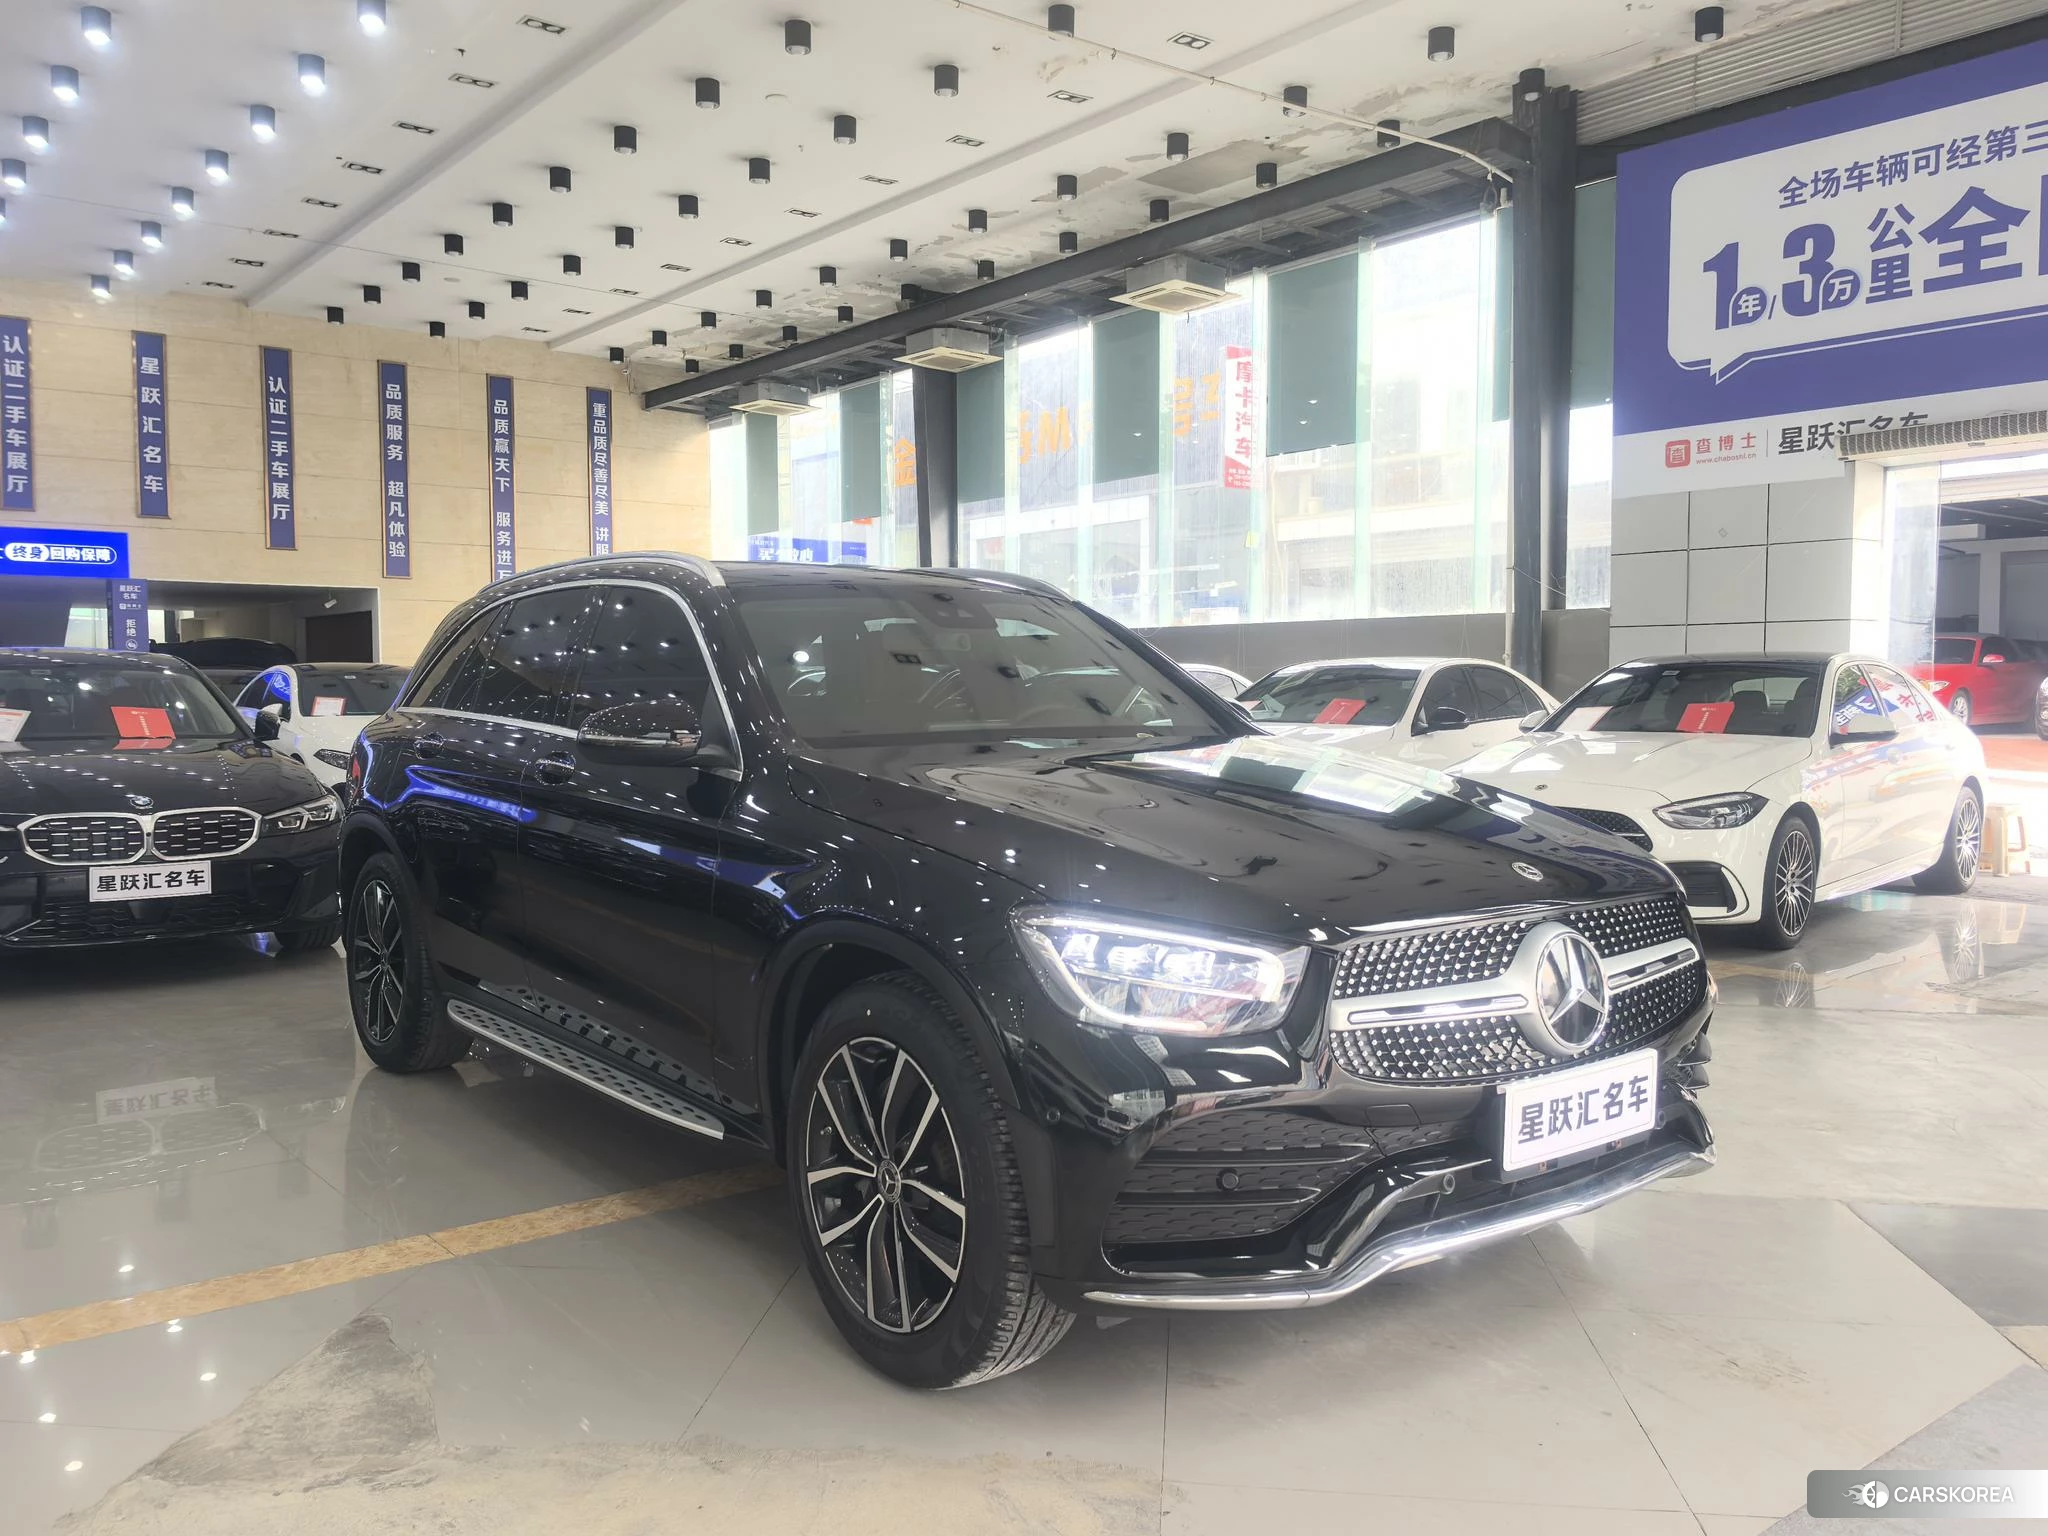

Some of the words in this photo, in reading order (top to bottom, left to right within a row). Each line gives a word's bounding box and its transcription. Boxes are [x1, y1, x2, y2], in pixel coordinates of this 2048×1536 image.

[1778, 119, 2048, 209] 全场车辆可经第三
[3, 335, 28, 493] 认证二手车展厅
[140, 357, 164, 493] 星跃汇名车
[268, 376, 290, 520] 认证二手车展厅
[386, 383, 403, 461] 品质服务
[494, 399, 510, 493] 品质赢天下
[1696, 432, 1757, 455] 查博士
[593, 403, 609, 516] 重品质尽善尽美
[388, 480, 406, 557] 超凡体验
[97, 869, 205, 893] 星跃汇名车
[1518, 1075, 1649, 1144] 星跃汇名车
